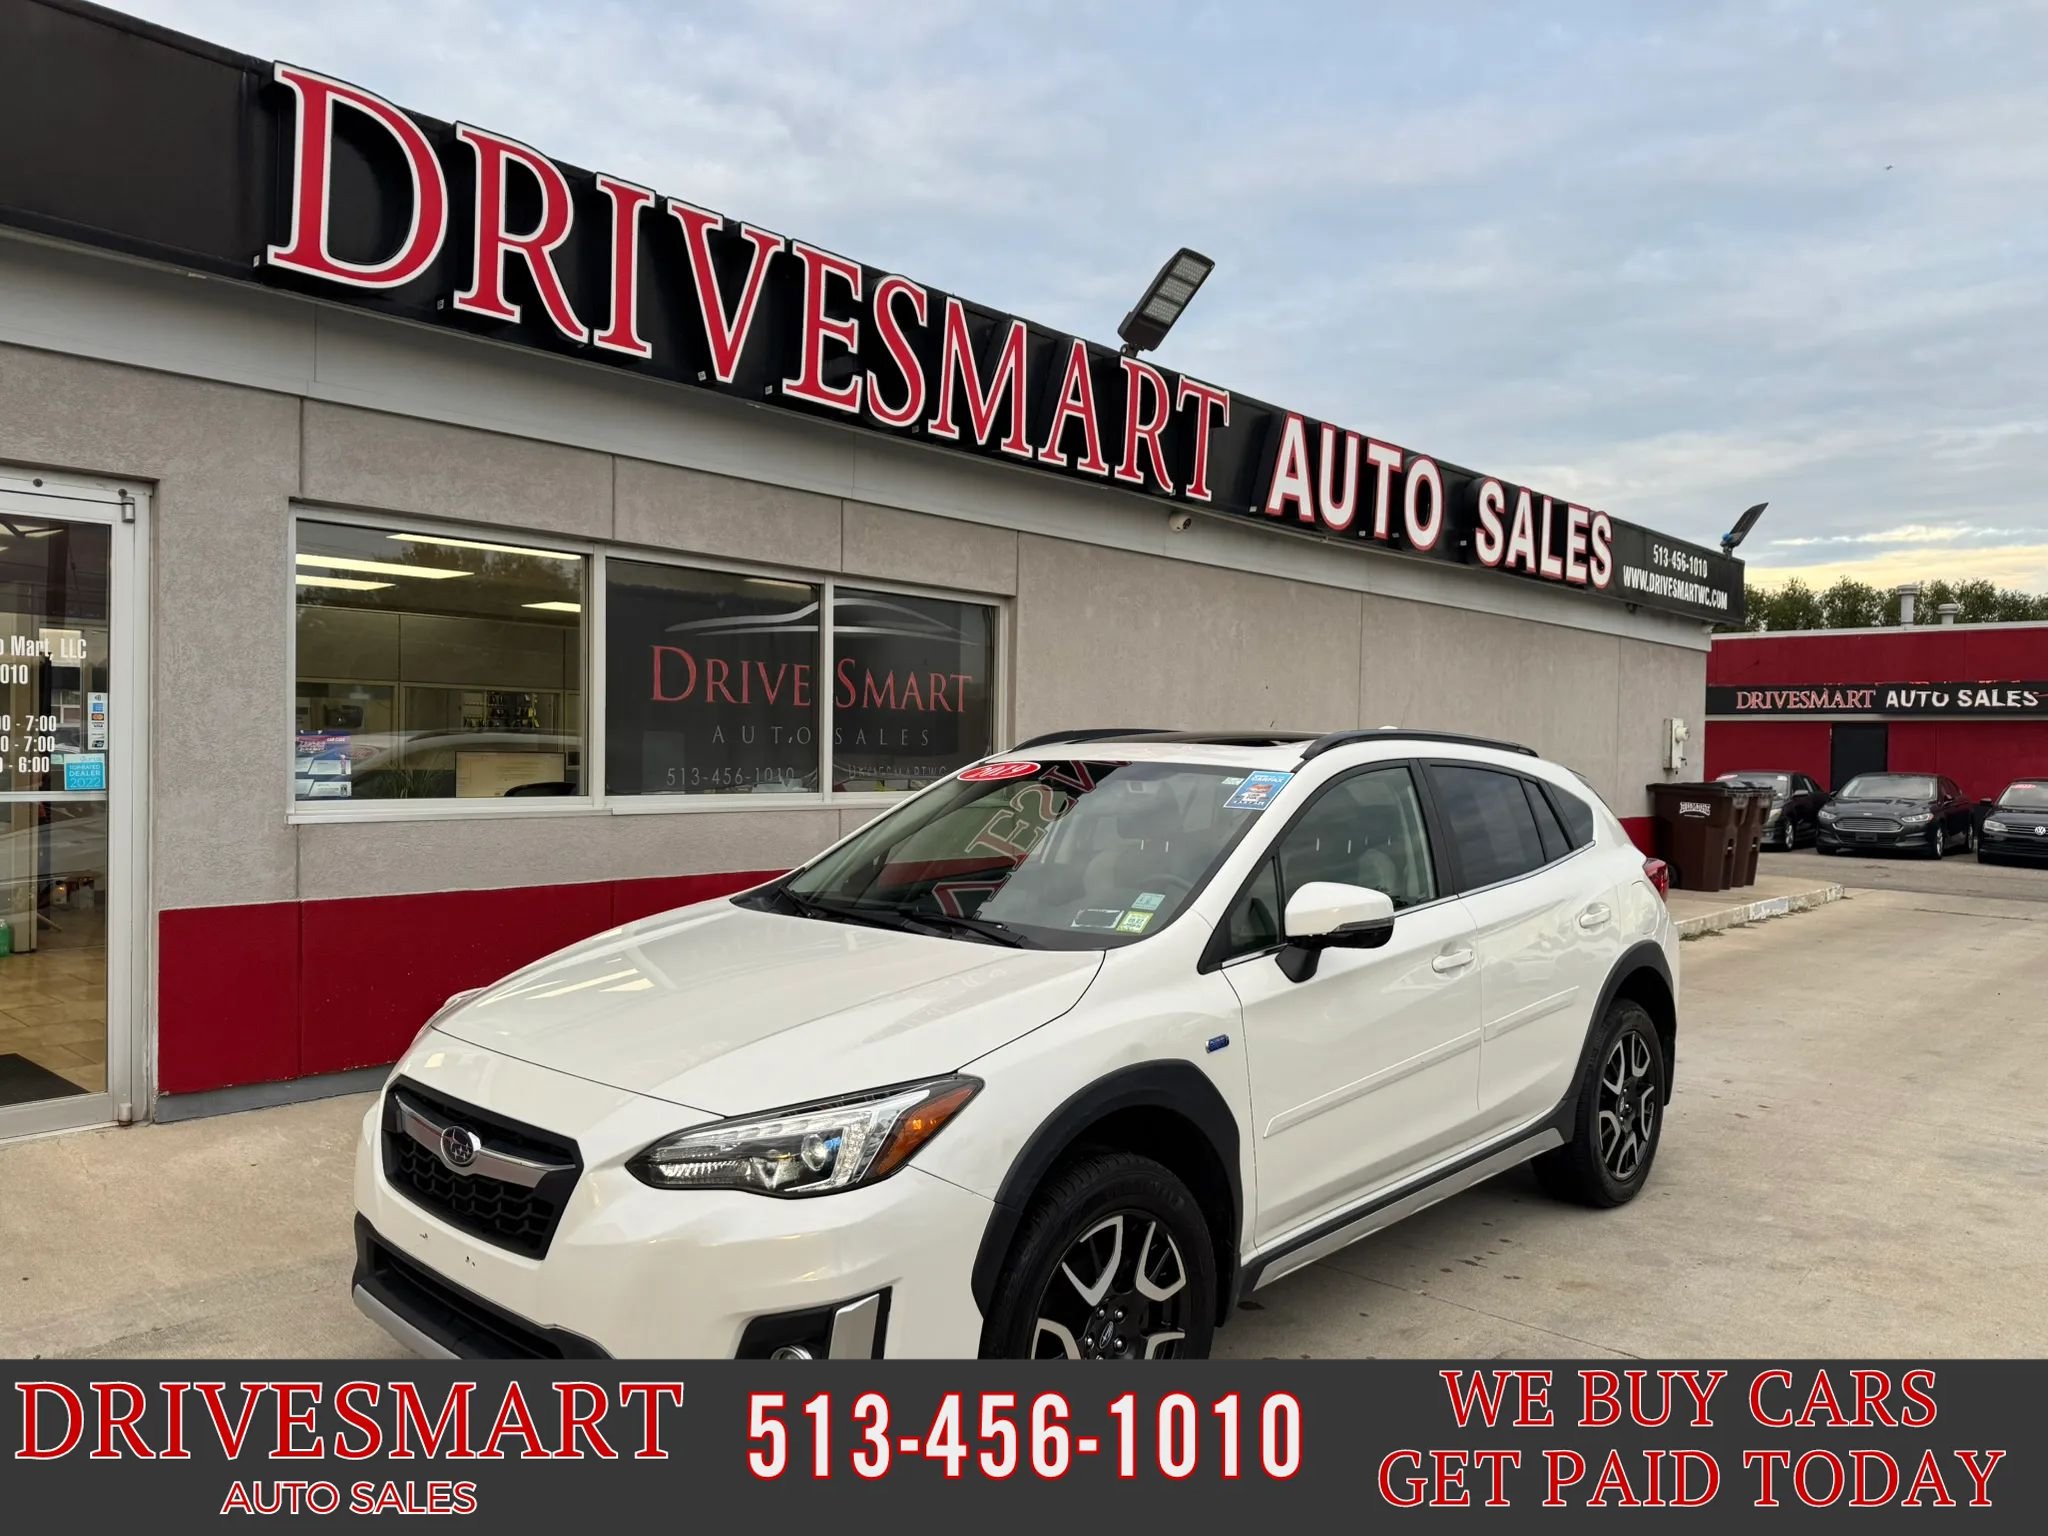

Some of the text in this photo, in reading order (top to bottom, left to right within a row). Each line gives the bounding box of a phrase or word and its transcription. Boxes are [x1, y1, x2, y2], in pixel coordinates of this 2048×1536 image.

[266, 60, 1614, 589] DRIVESMART AUTO SALES
[1653, 544, 1708, 579] 513-456-1010
[1622, 565, 1728, 610] WWW.DRIVESMARTWC.COM
[10, 635, 54, 661] Mart,
[60, 638, 87, 660] LLC
[649, 645, 973, 713] DRIVE SMART
[1736, 688, 2039, 710] DRIVESMART AUTO SALES
[25, 715, 57, 732] 7:00
[24, 736, 55, 752] 7:00
[712, 725, 929, 746] AUTO SALES
[19, 756, 50, 773] 6:00
[69, 777, 101, 788] 2022
[666, 767, 795, 786] 513-456-1010
